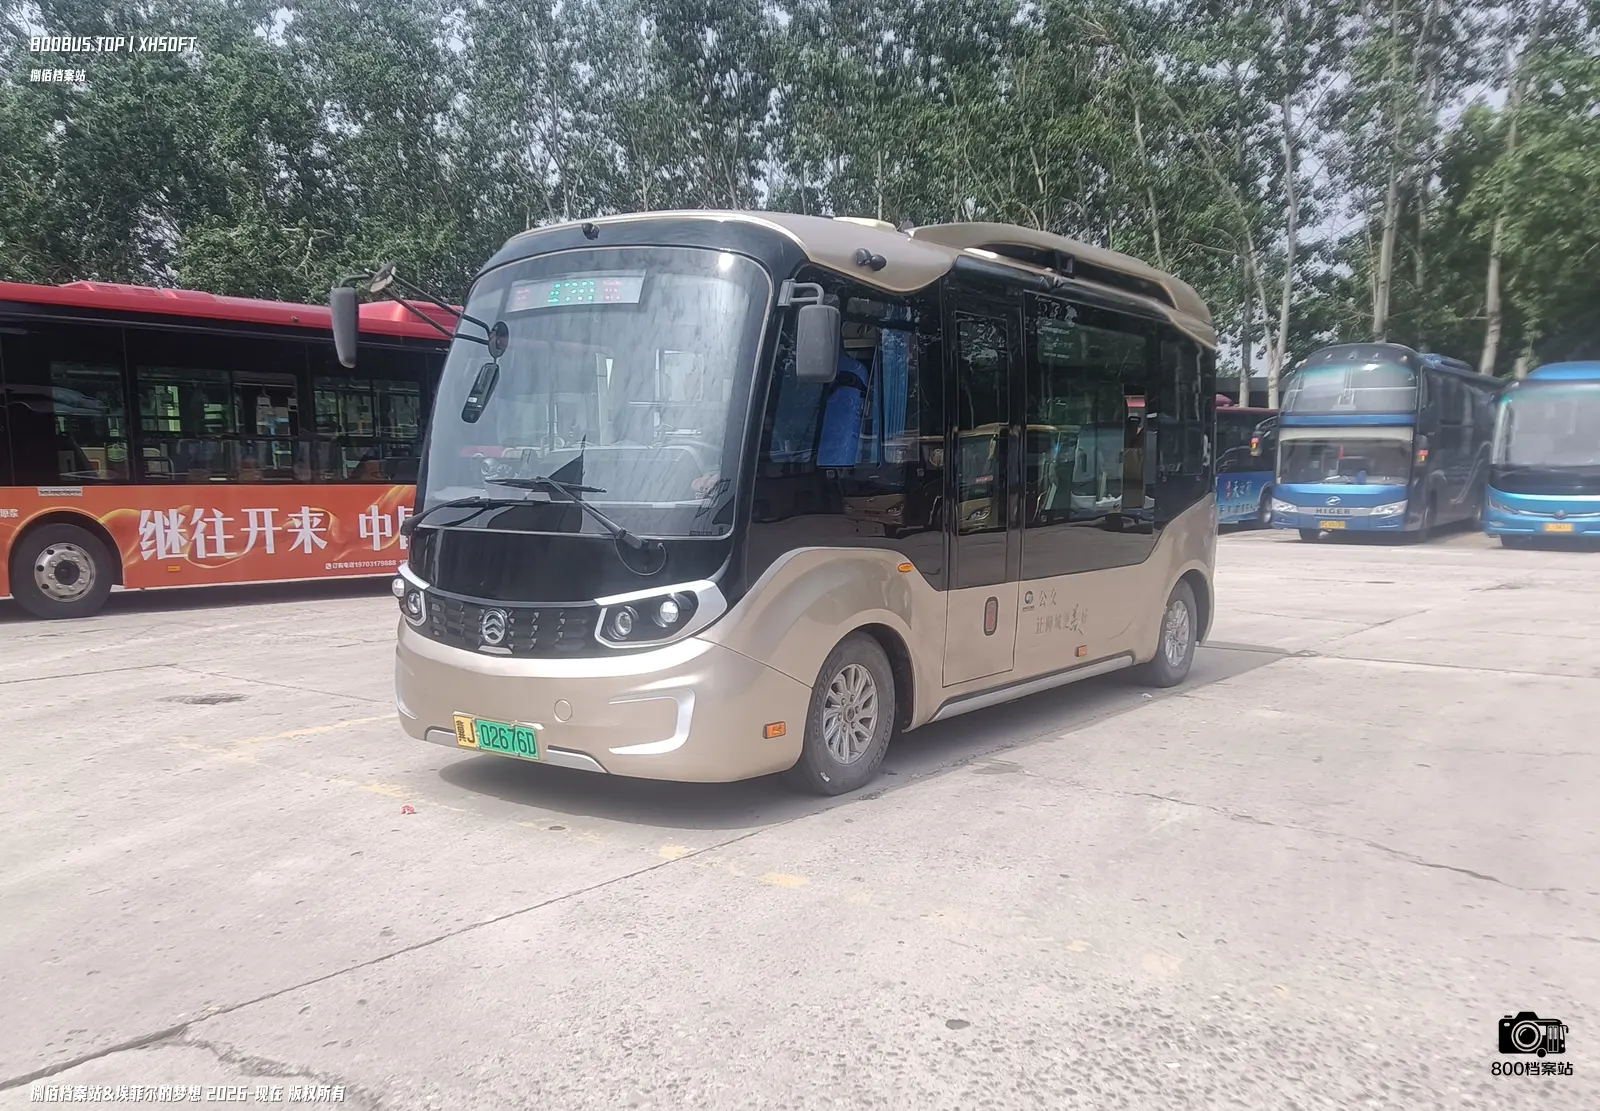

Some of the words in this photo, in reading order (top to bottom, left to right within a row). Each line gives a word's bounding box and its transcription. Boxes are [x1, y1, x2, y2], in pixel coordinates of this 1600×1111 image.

[1315, 507, 1351, 515] HIGER
[138, 505, 329, 561] 继往开来
